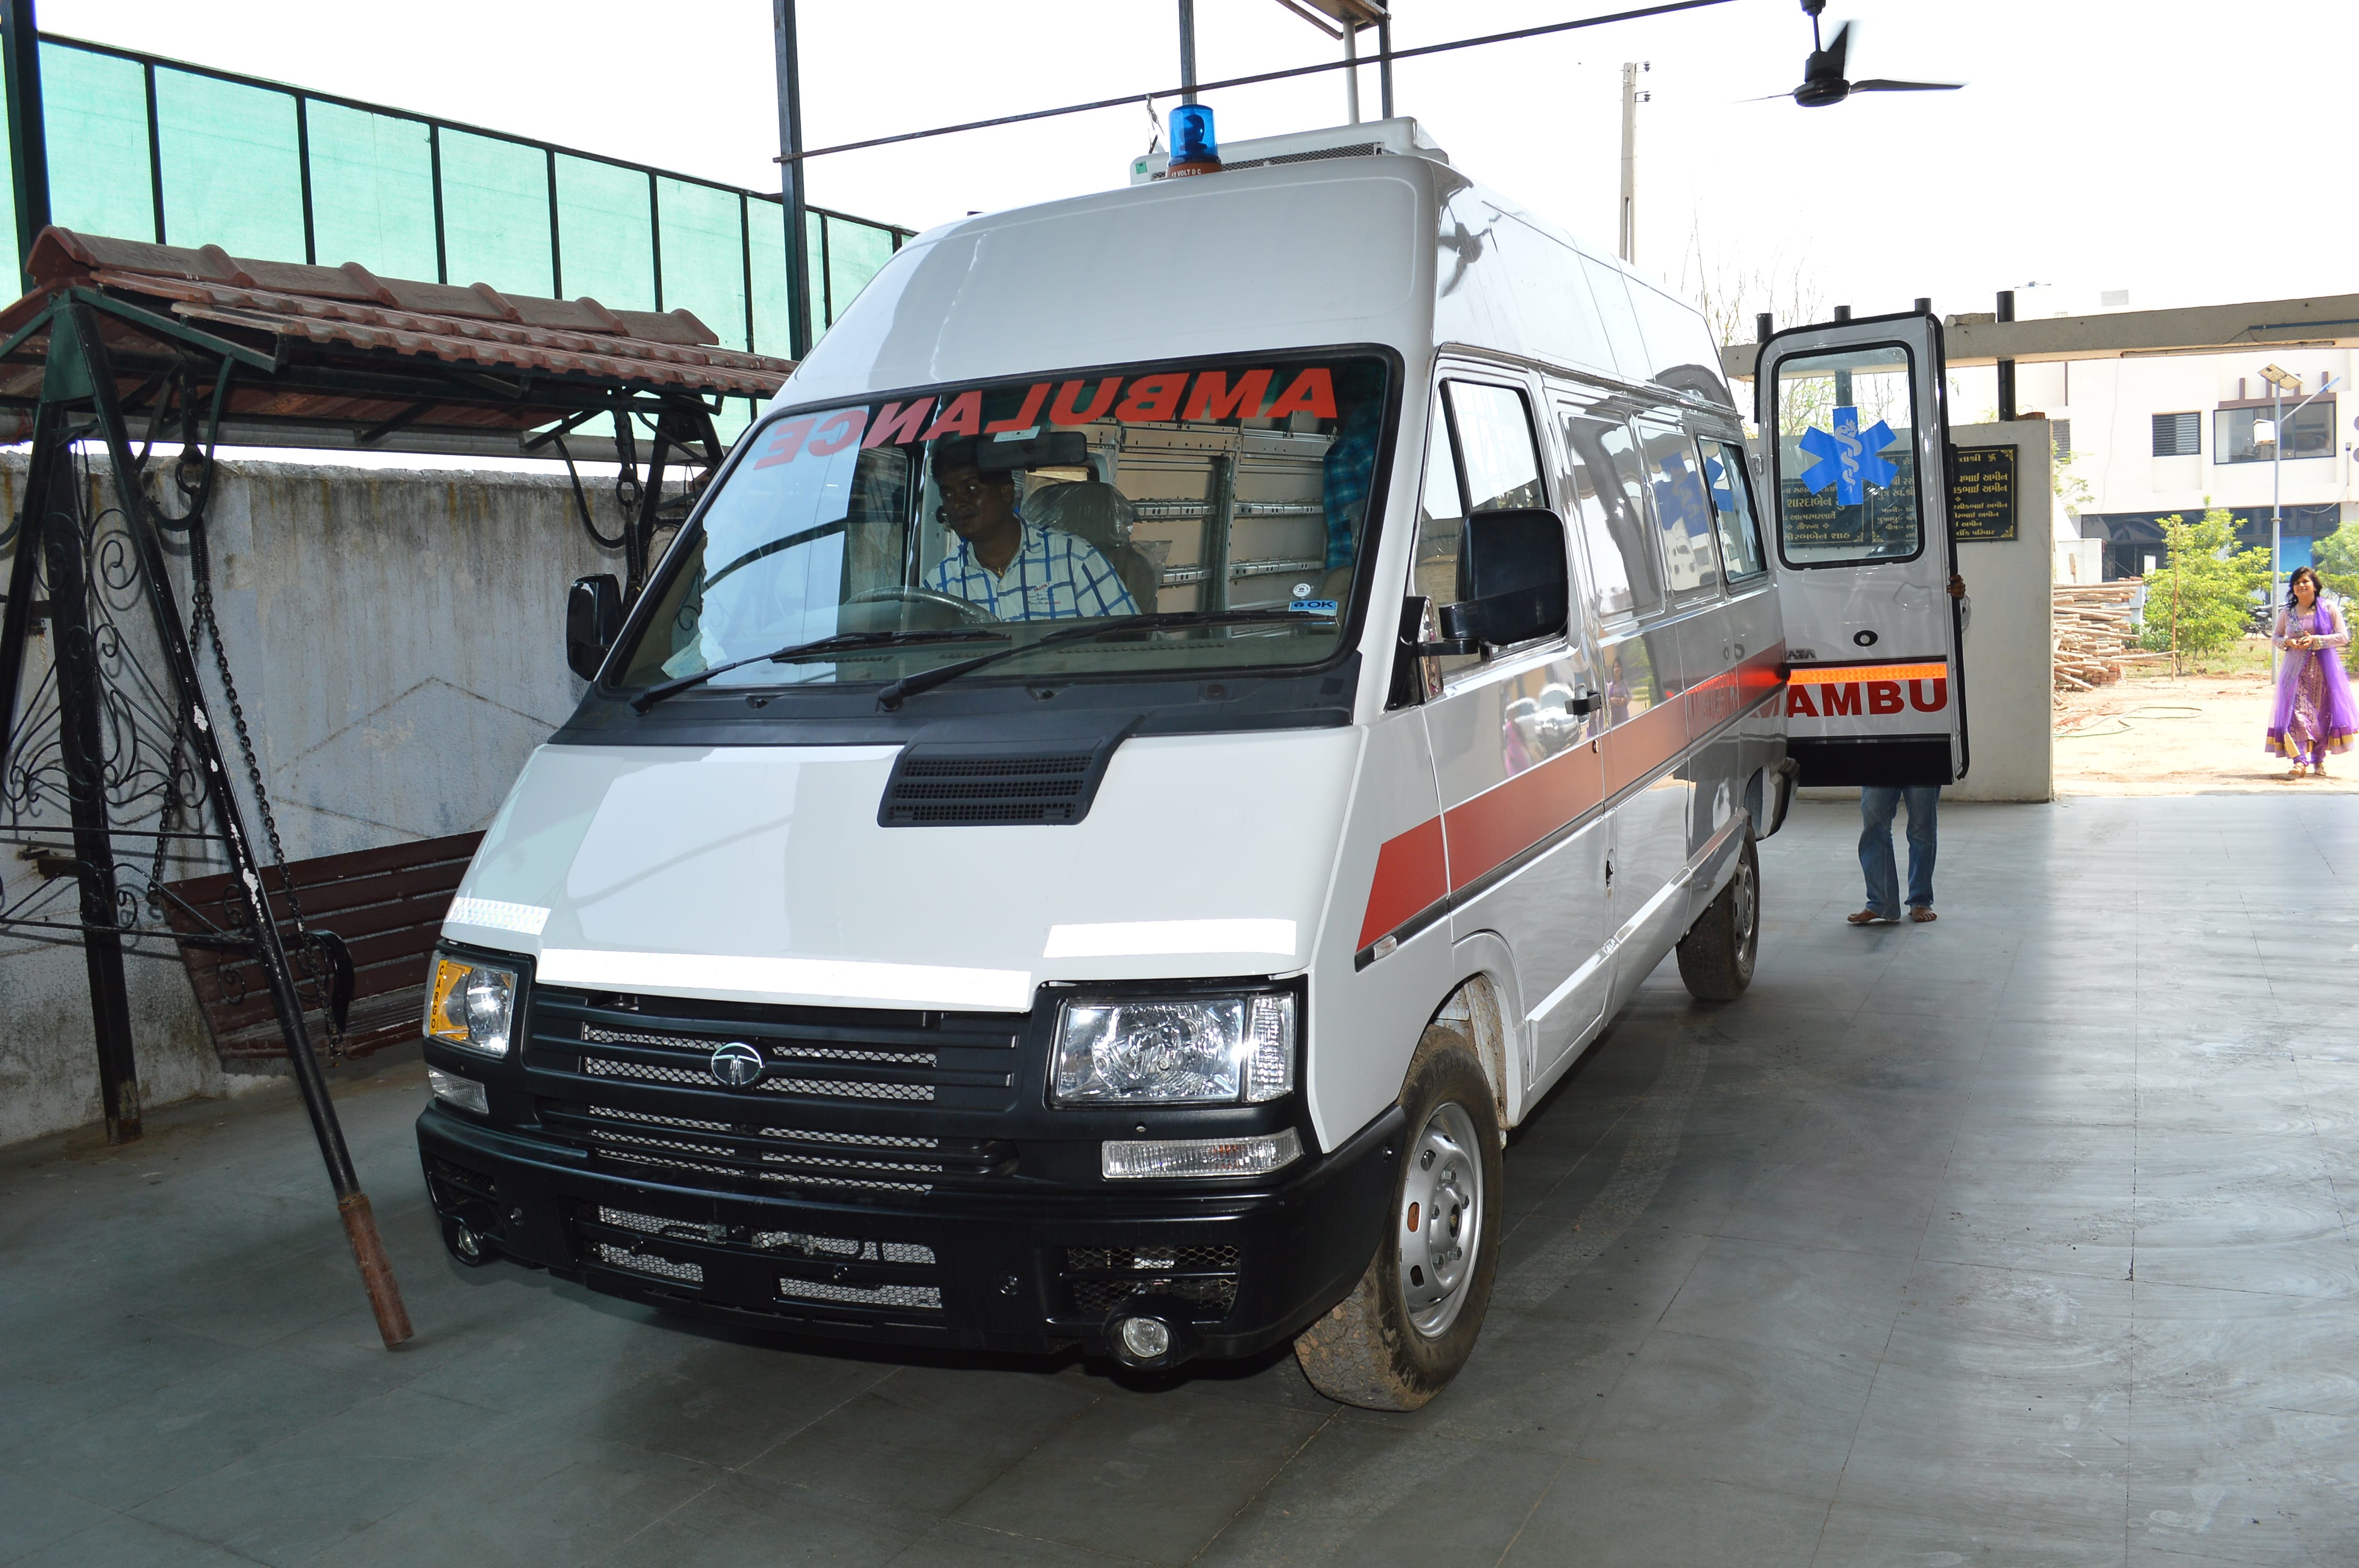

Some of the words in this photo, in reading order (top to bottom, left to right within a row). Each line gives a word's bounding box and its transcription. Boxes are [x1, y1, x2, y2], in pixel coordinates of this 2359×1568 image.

[1177, 169, 1190, 177] VOLT
[1983, 471, 2008, 481] અમીન
[1982, 482, 2008, 492] અમીન
[1787, 494, 1832, 508] શારદાબેન
[1788, 678, 1948, 718] AMBU
[431, 965, 445, 1029] CARGO
